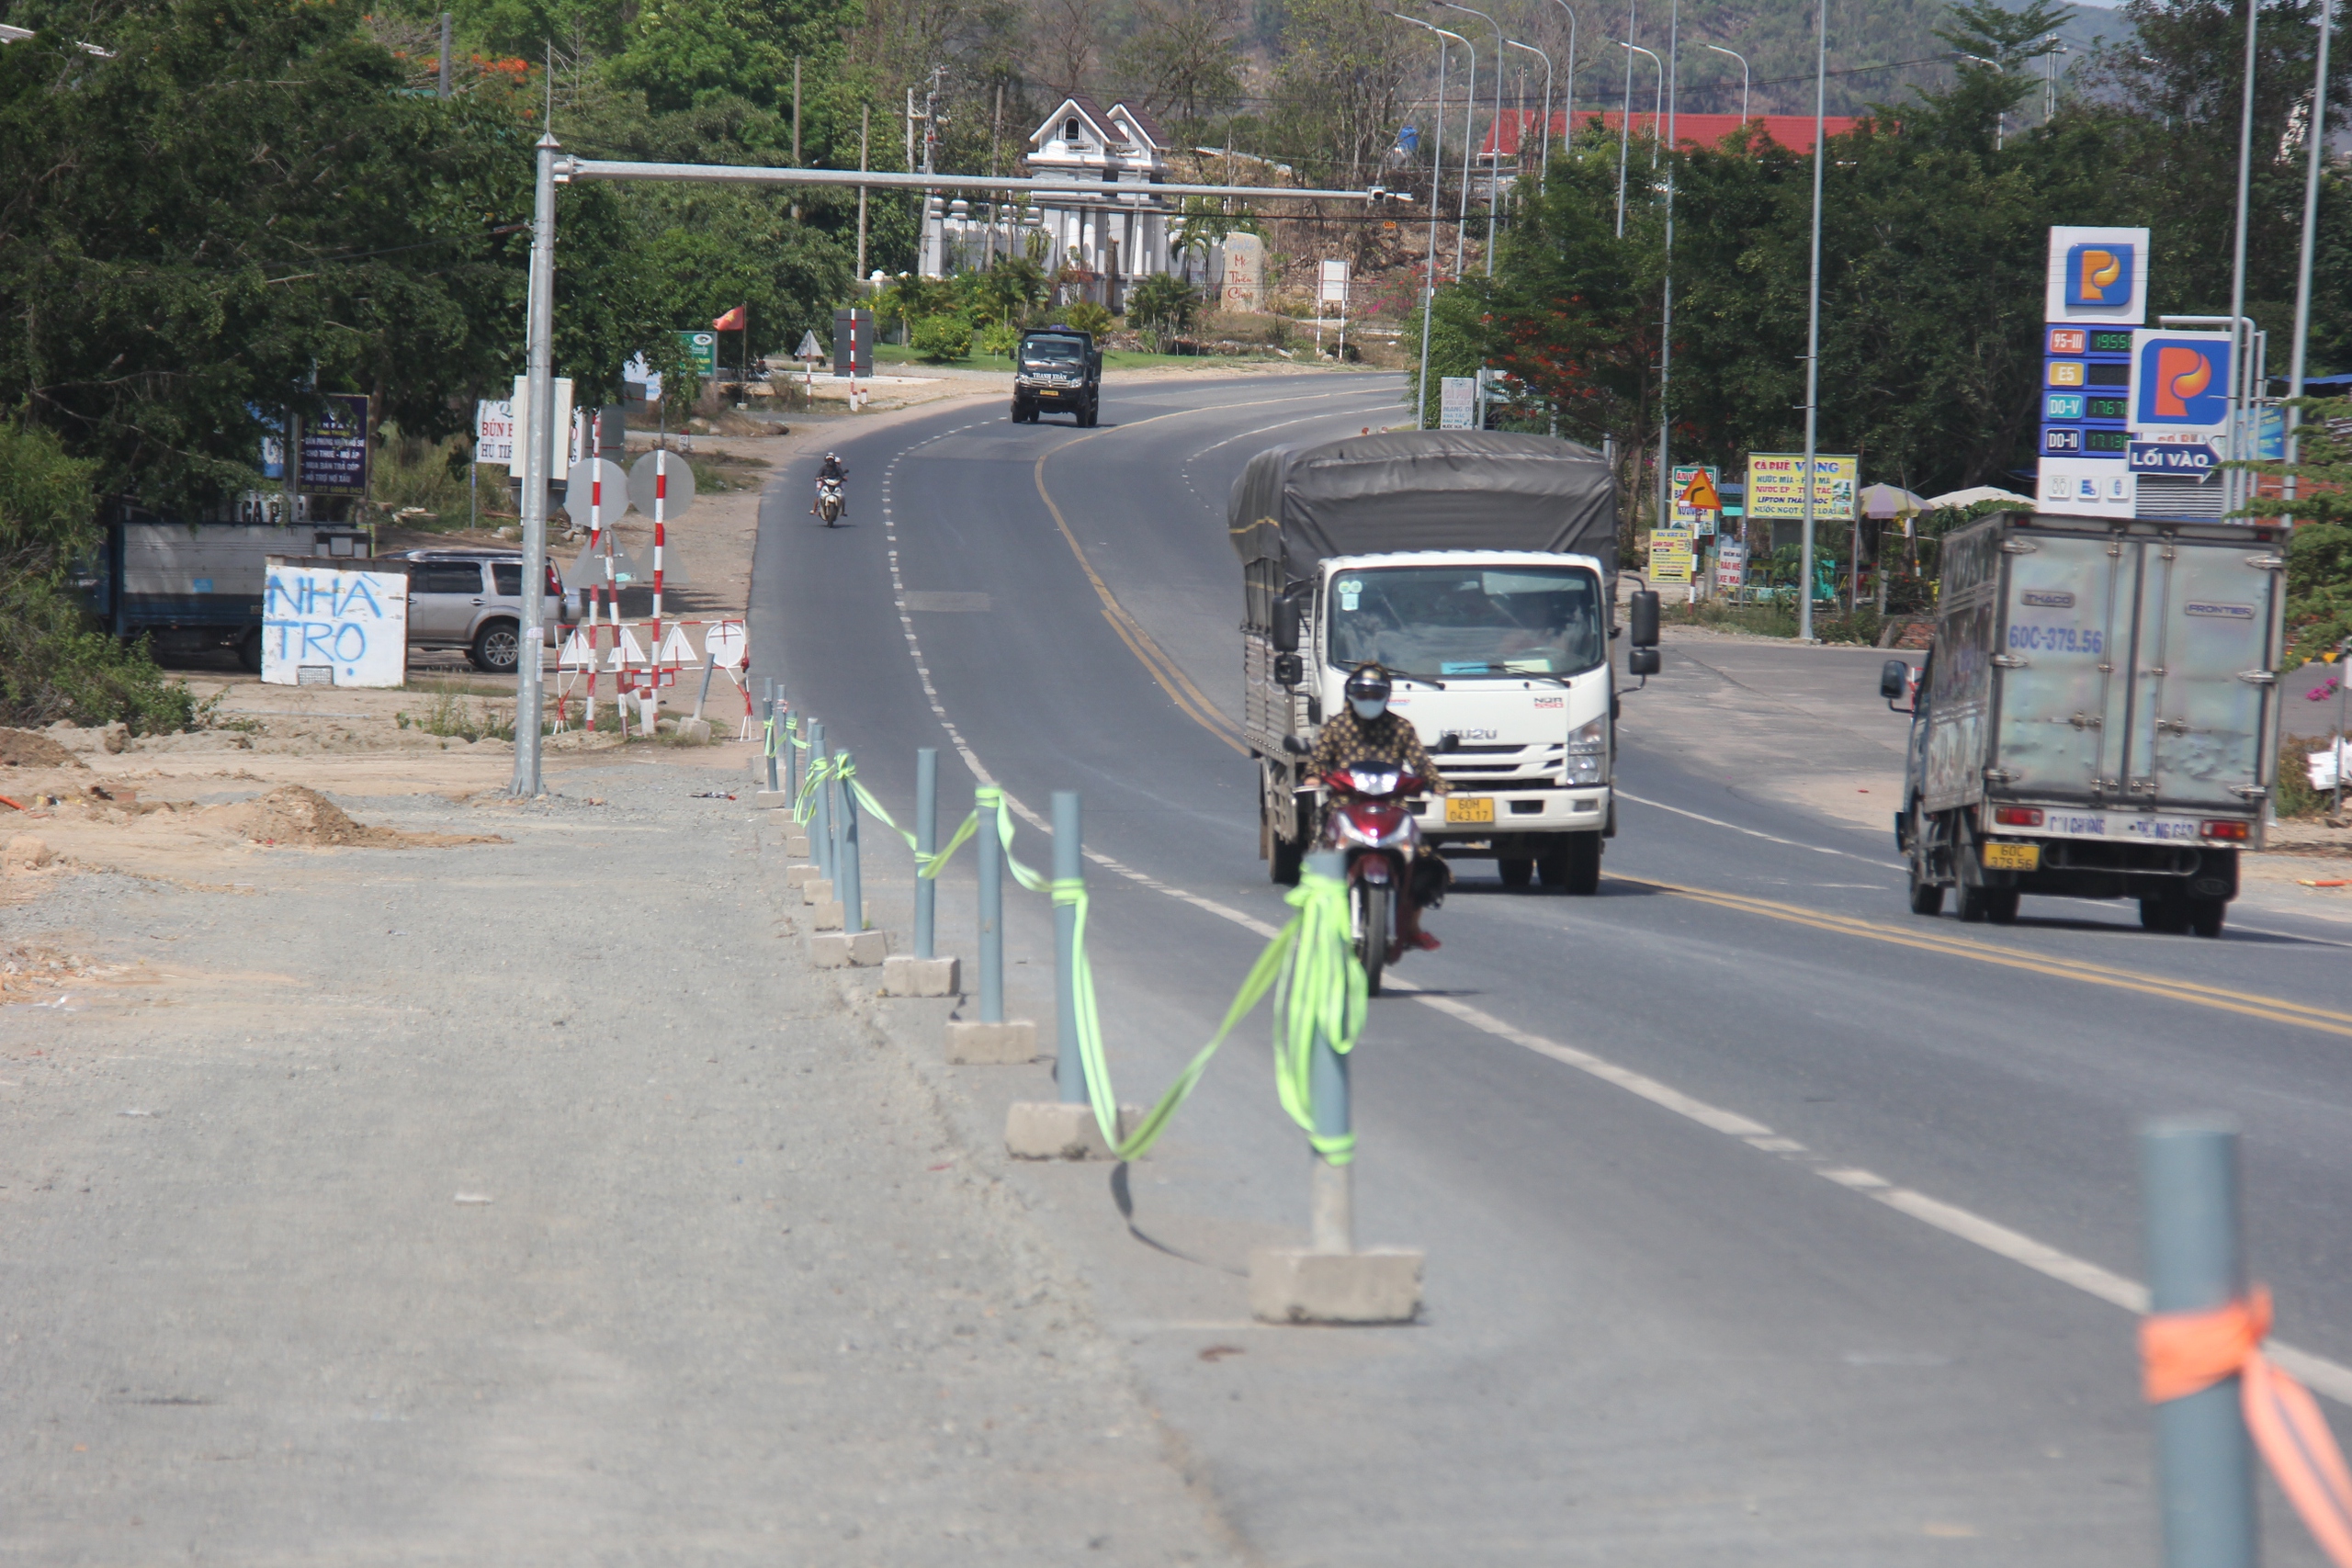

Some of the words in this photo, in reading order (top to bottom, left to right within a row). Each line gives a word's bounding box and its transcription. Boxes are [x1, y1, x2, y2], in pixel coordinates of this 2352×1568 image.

[2054, 334, 2082, 349] 95-III
[2058, 366, 2075, 381] E5
[2051, 400, 2079, 414] DO-V
[482, 418, 504, 437] BÚN
[2049, 434, 2078, 448] DO-II
[2132, 448, 2163, 466] LỐI
[2167, 450, 2209, 467] VÀO
[1754, 460, 1766, 470] CÀ
[1769, 460, 1791, 470] PHÊ
[1795, 462, 1839, 473] VNG
[1777, 507, 1799, 515] NGỌT
[1719, 575, 1728, 583] XE
[267, 572, 382, 618] NHÀ
[2025, 594, 2071, 604] THACO
[2188, 604, 2252, 615] FRONTIER
[2009, 625, 2103, 654] 60C-379.56
[264, 620, 366, 677] TRỌ
[1459, 799, 1480, 809] 60H
[1450, 811, 1488, 821] 043.17
[2001, 846, 2024, 856] 60C
[1991, 857, 2032, 870] 379.56
